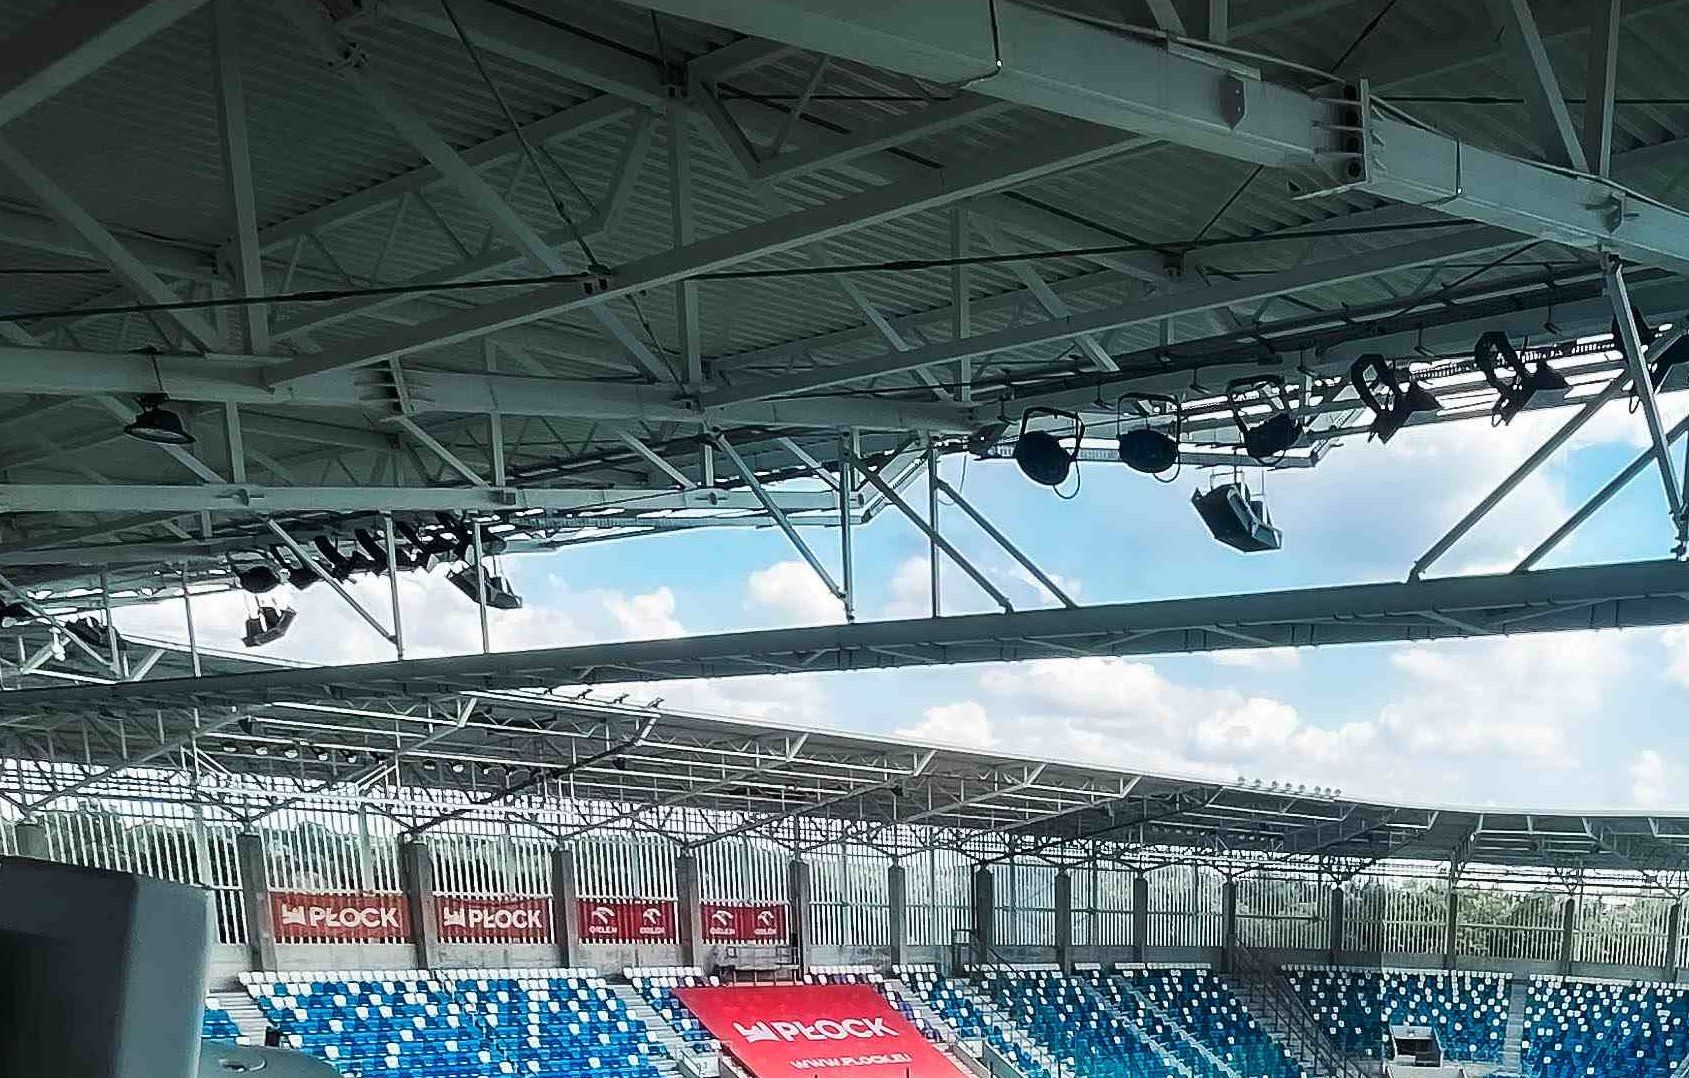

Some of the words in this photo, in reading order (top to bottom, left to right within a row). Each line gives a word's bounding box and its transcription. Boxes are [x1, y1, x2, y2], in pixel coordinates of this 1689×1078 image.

[310, 906, 399, 928] PŁOCK
[468, 908, 542, 929] PŁOCK
[772, 1016, 899, 1042] PŁOCK
